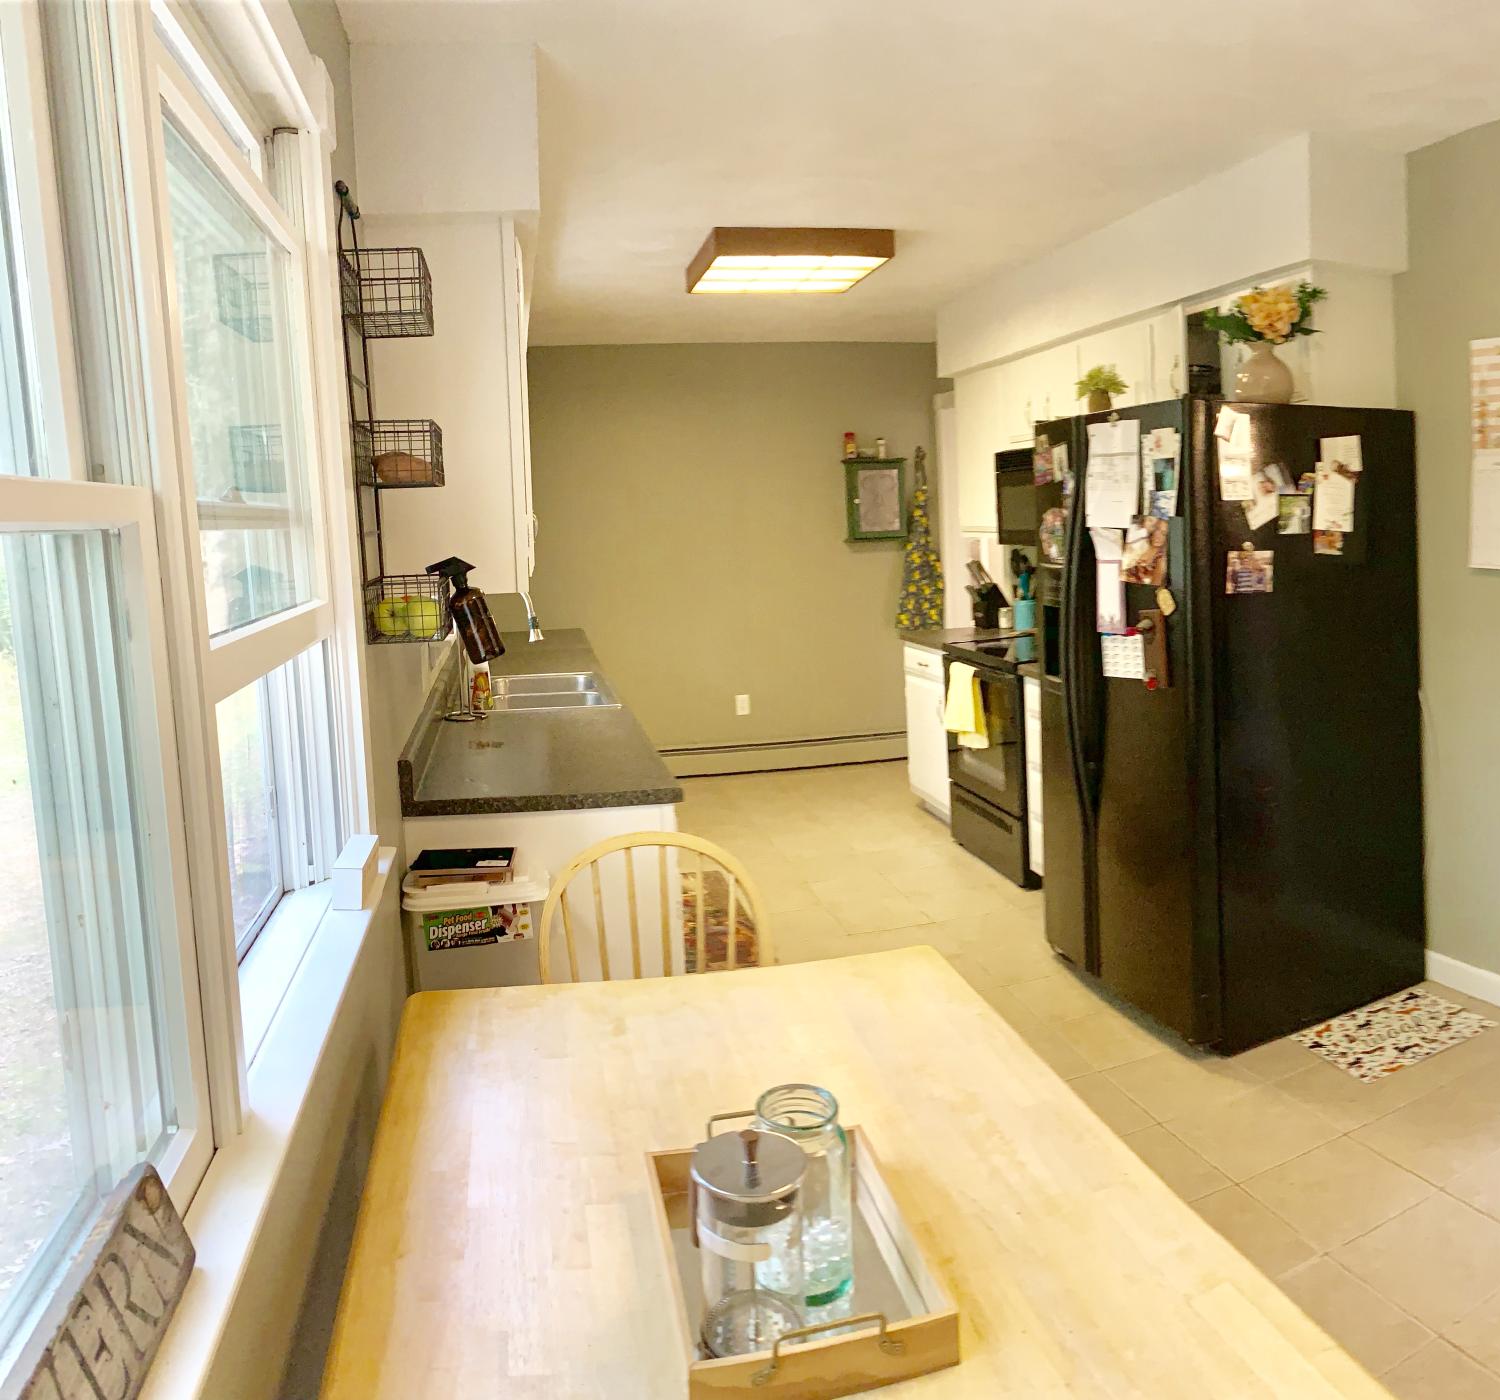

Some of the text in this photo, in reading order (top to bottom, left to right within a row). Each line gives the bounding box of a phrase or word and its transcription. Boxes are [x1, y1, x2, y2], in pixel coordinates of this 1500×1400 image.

[443, 916, 455, 926] Pet
[455, 913, 473, 923] Food
[429, 918, 488, 940] Dispenser
